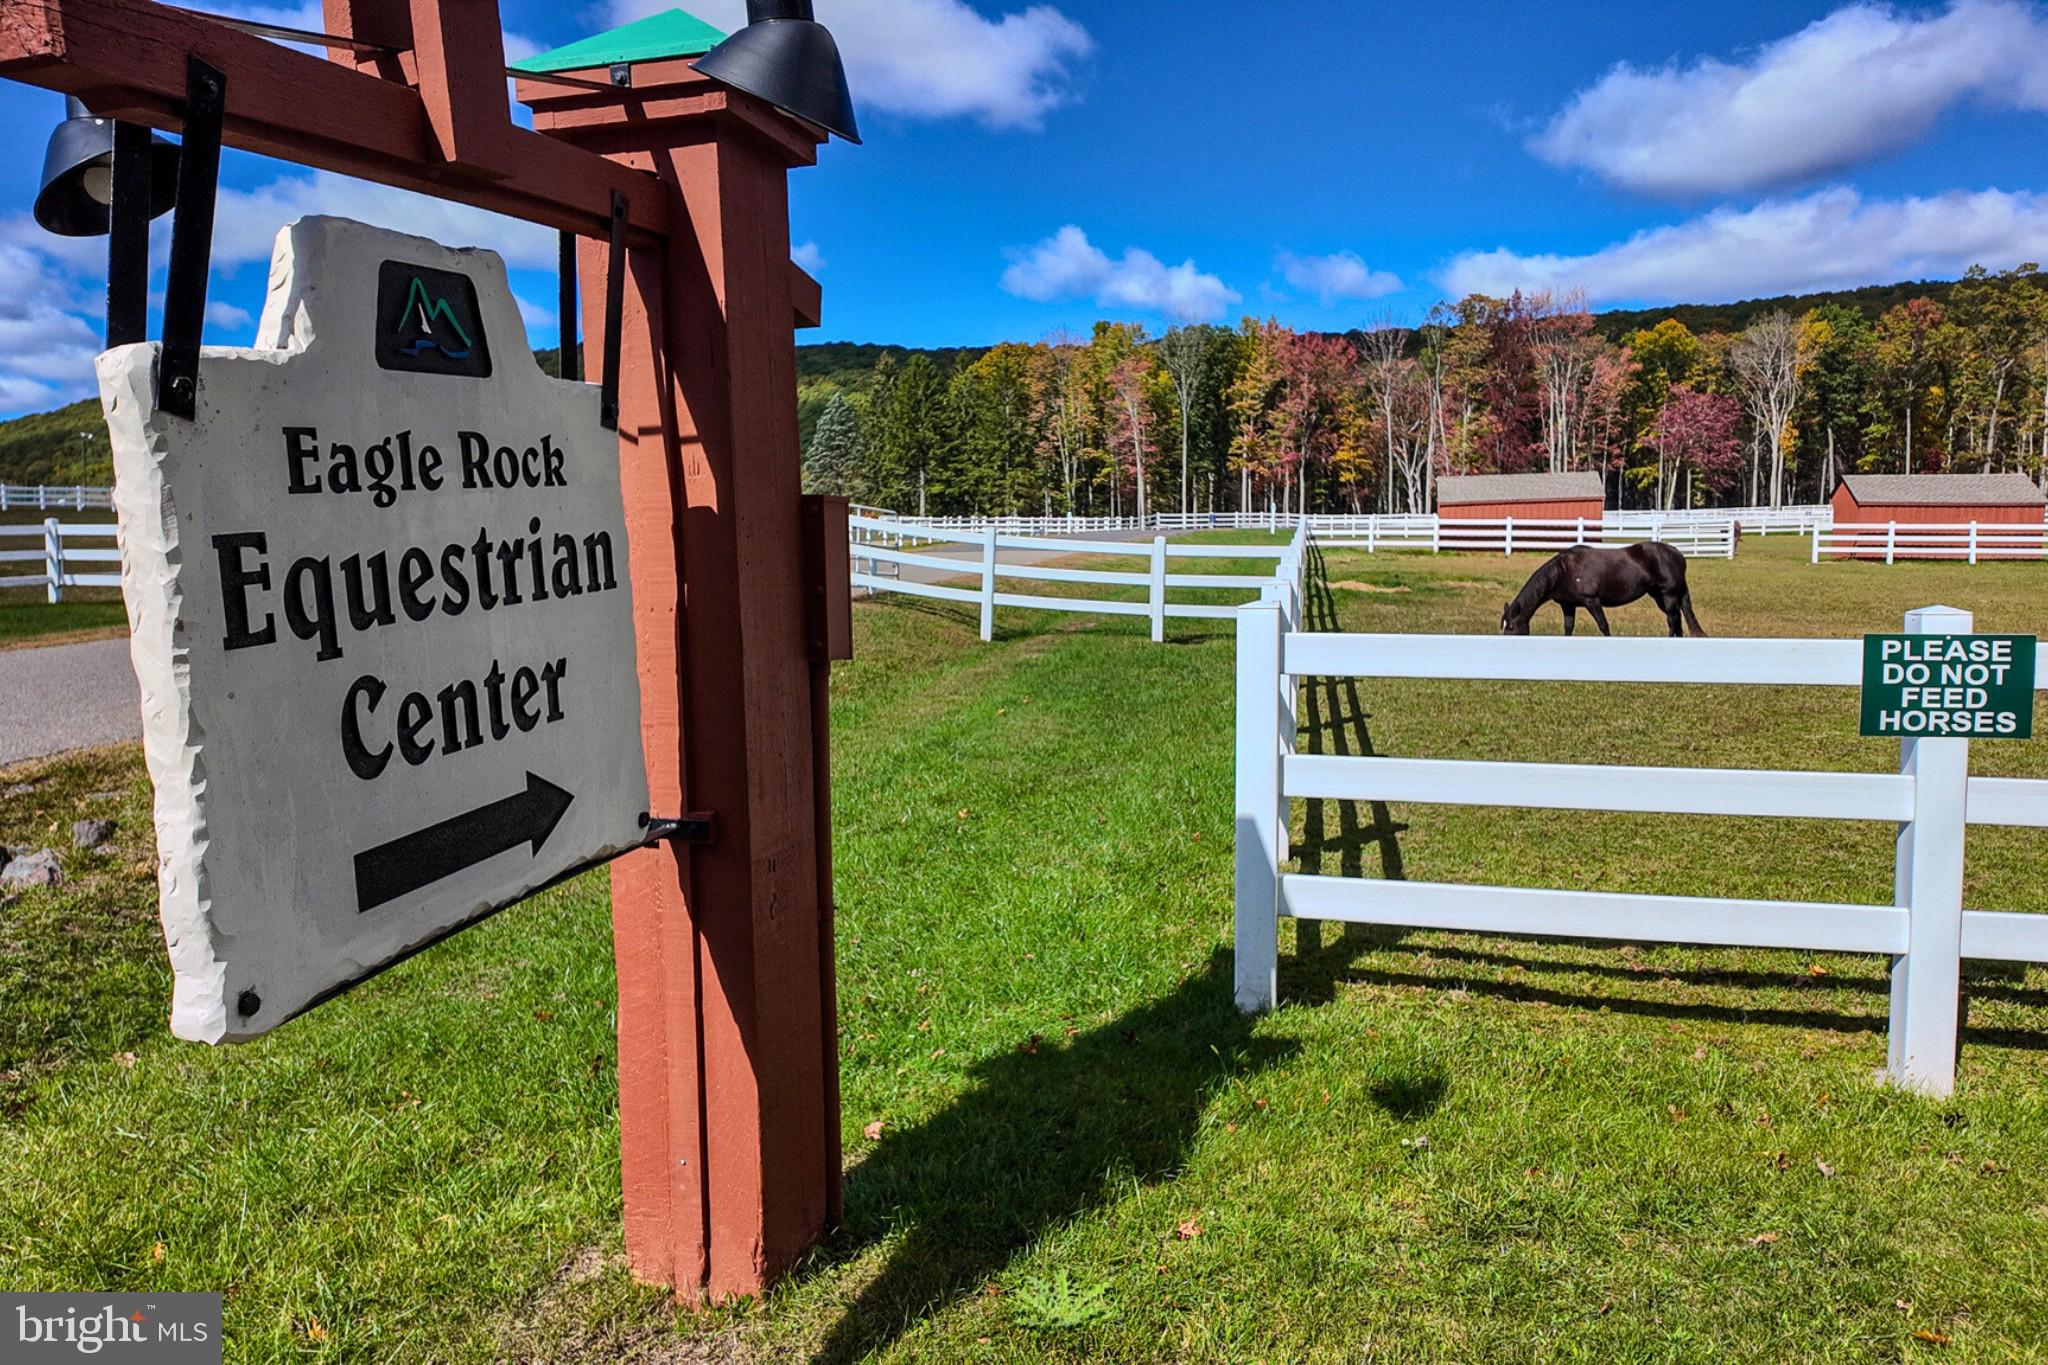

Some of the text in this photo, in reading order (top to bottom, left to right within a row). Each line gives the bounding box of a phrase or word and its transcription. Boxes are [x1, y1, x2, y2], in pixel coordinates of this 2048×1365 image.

[282, 426, 568, 508] Eagle Rock
[212, 517, 617, 662] Equestrian
[1881, 639, 2012, 661] PLEASE
[1882, 663, 2011, 686] DO NOT
[1901, 687, 1988, 709] FEED
[341, 656, 567, 780] Center
[1879, 710, 2017, 733] HORSES
